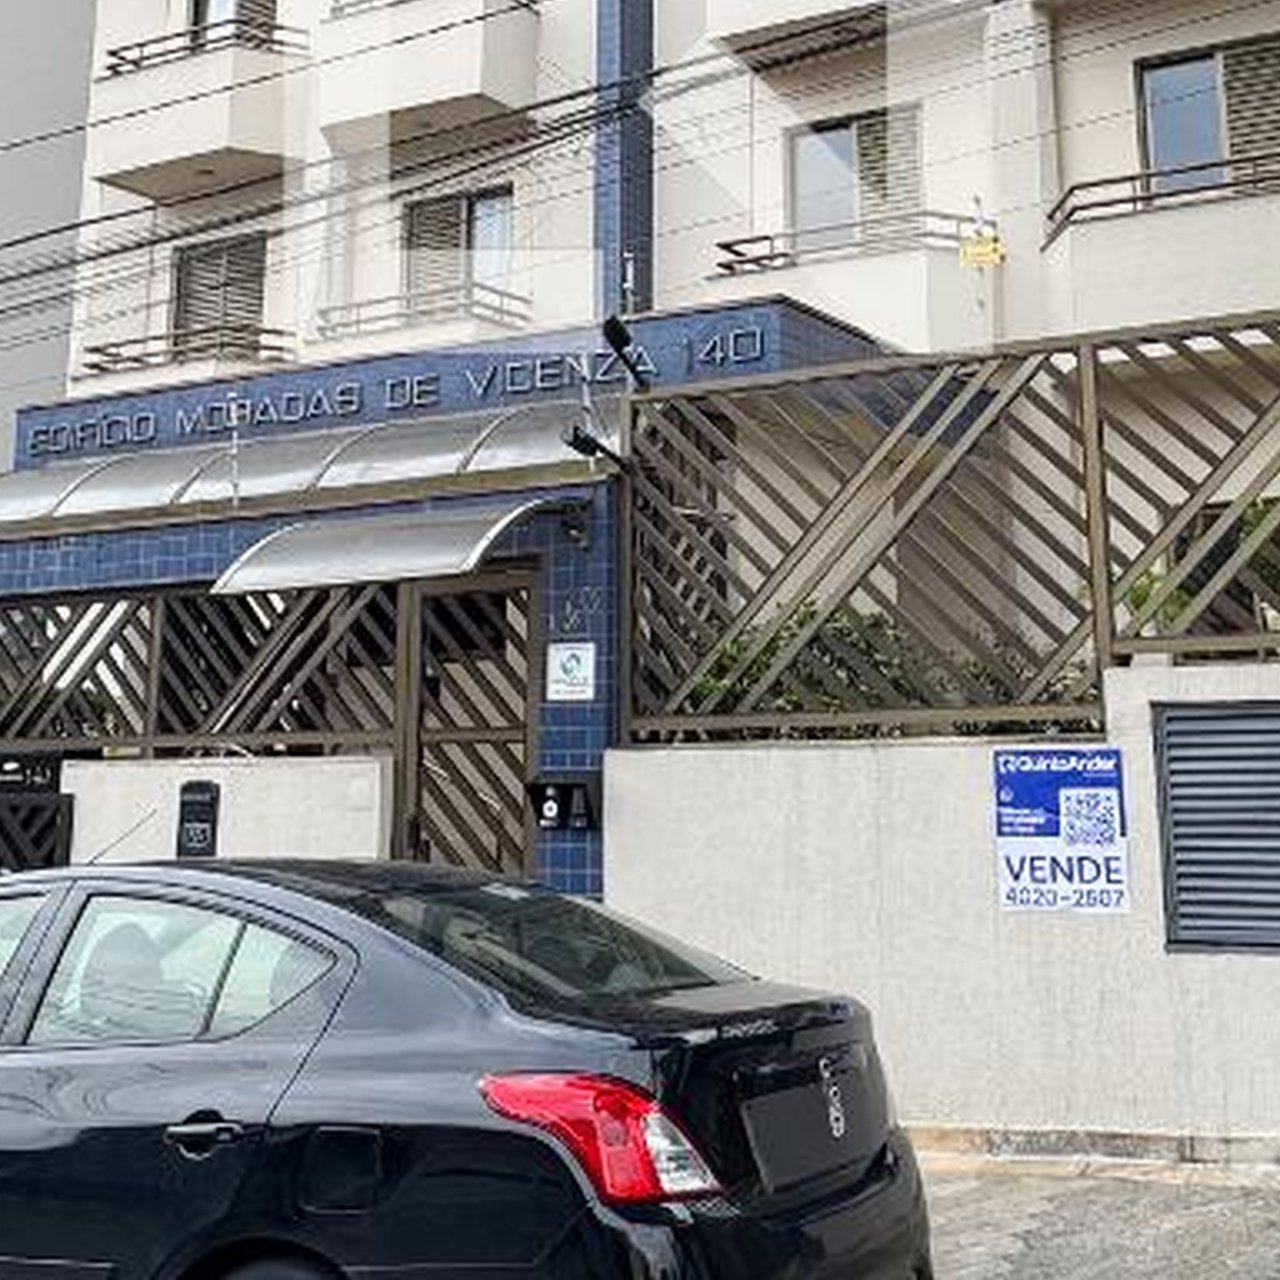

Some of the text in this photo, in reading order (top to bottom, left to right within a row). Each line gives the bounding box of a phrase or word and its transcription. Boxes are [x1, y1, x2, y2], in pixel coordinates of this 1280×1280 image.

[176, 383, 361, 436] MORADAS
[385, 374, 441, 410] DE
[681, 326, 764, 373] 140
[1004, 855, 1124, 884] VENDE
